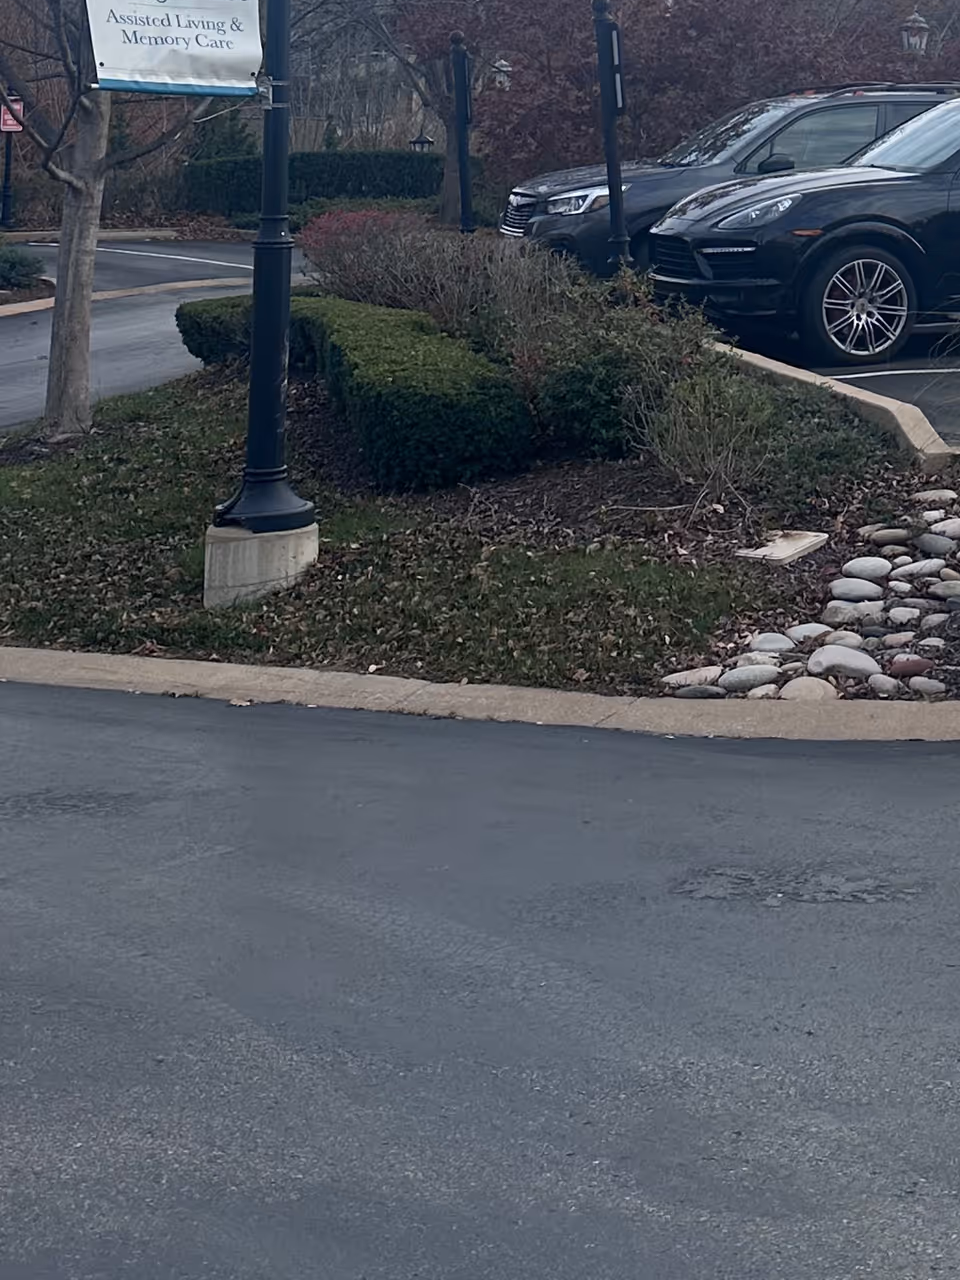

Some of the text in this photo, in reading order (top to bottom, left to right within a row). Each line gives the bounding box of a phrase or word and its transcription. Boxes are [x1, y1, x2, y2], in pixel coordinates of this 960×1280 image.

[106, 8, 244, 36] Assisted Living &
[121, 29, 235, 50] Memory Care
